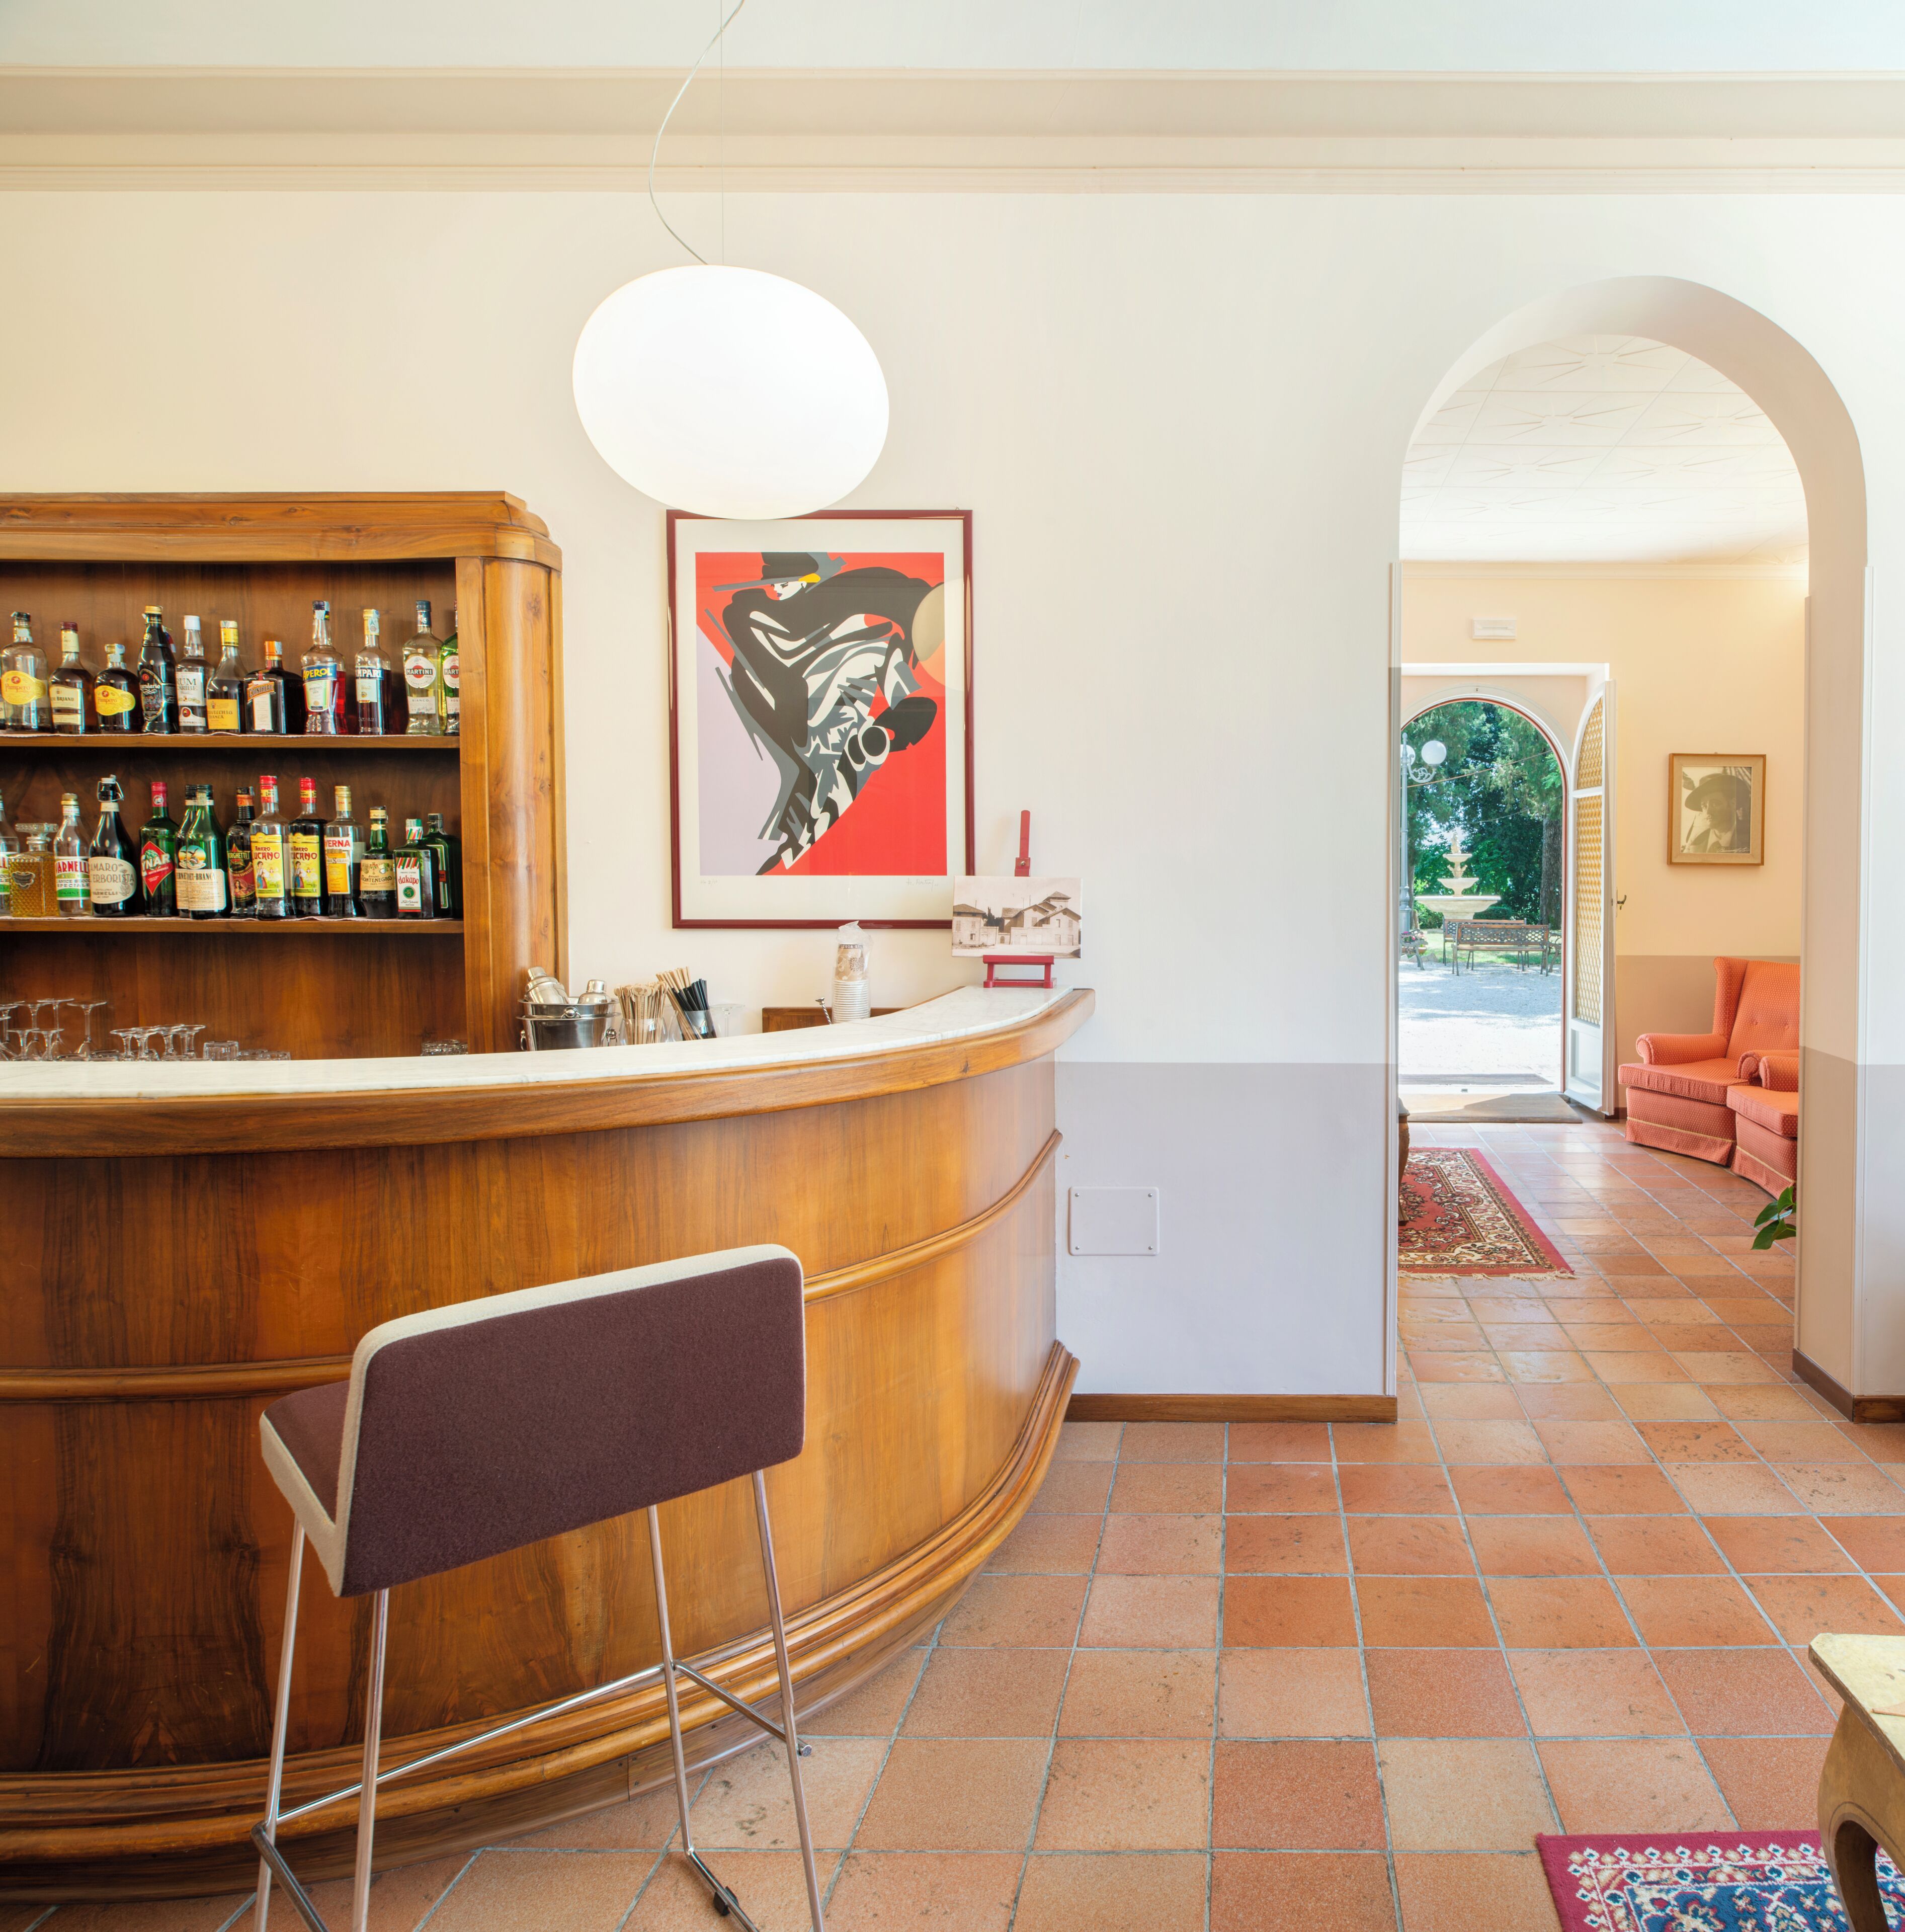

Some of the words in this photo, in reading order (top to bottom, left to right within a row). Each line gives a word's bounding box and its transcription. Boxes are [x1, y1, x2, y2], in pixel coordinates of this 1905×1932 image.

[303, 668, 333, 680] APEROL
[356, 669, 382, 677] AMPARI
[5, 684, 31, 693] Pampero
[90, 862, 118, 872] AMARO
[398, 874, 420, 885] dakapo
